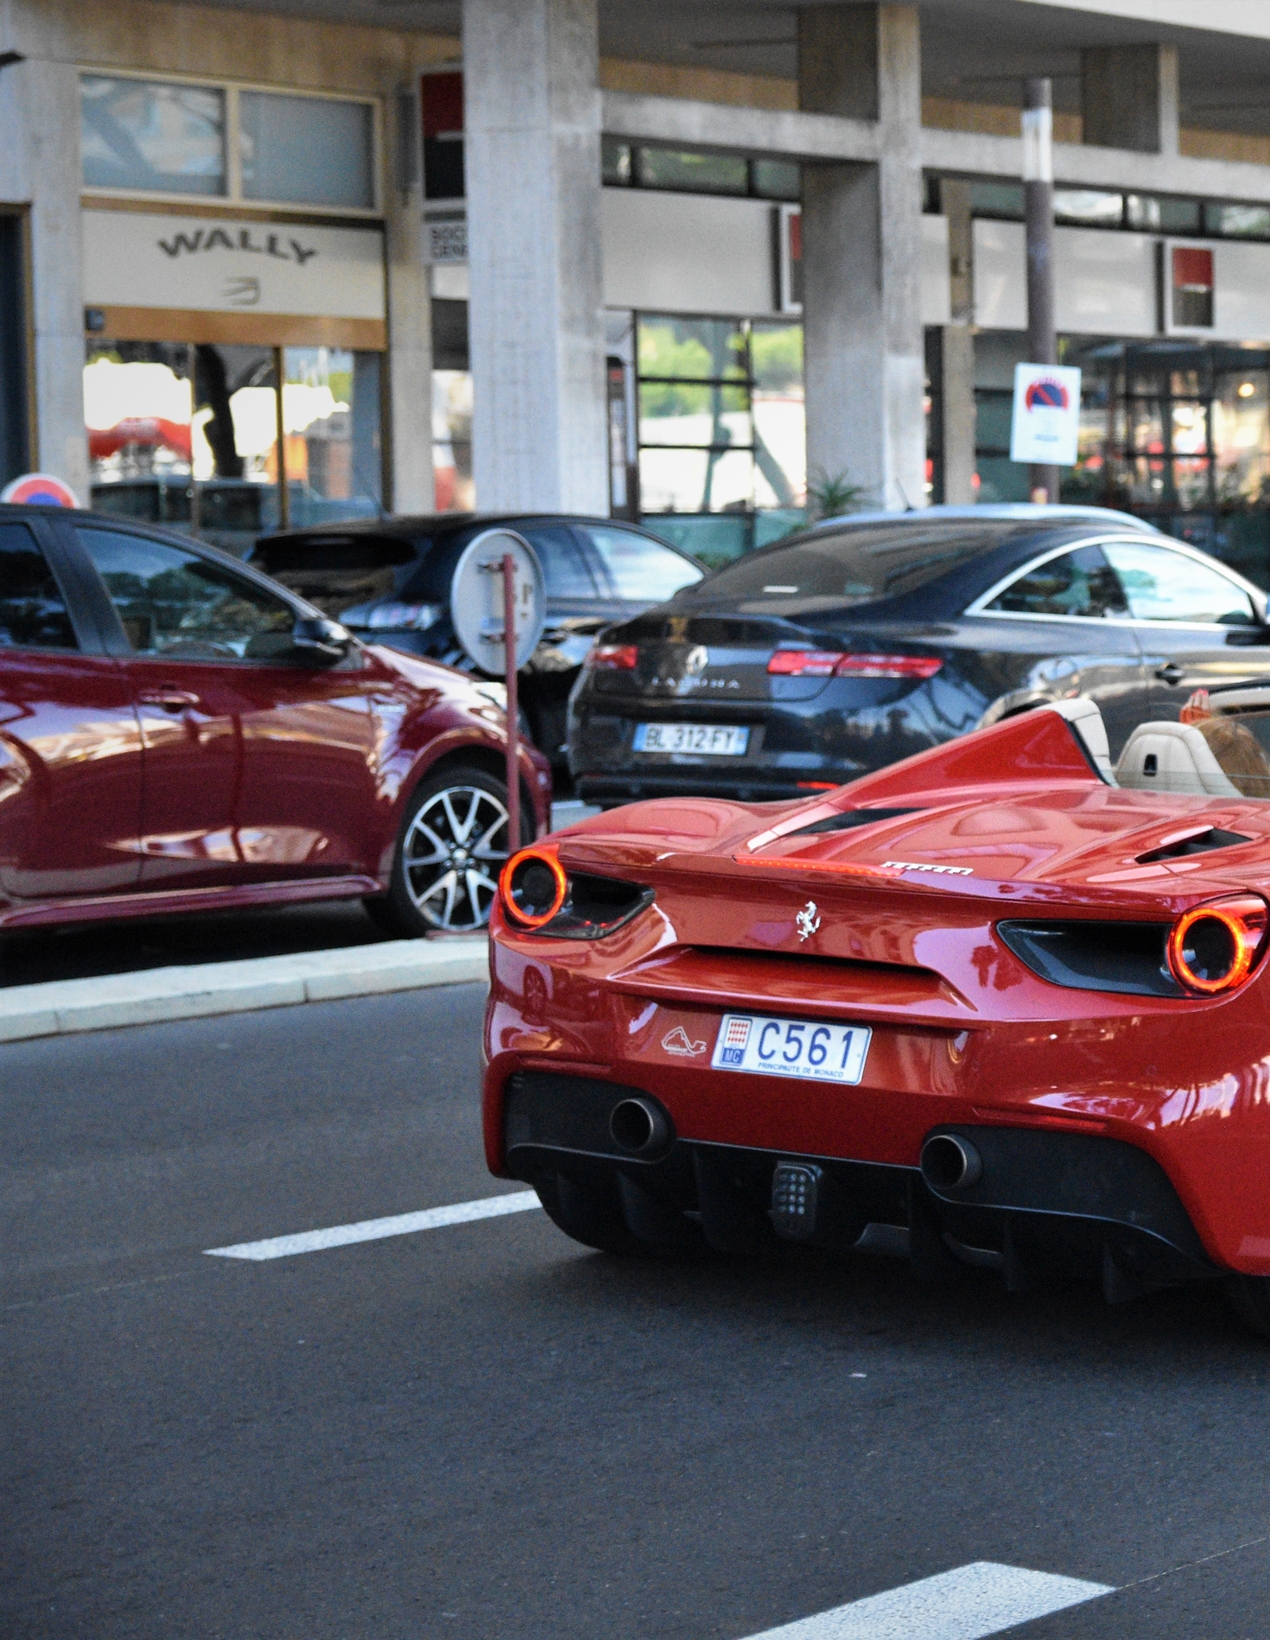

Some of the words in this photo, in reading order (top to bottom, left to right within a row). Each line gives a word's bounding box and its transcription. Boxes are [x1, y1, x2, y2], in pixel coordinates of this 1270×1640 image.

[158, 229, 316, 265] WALLY
[726, 1049, 741, 1063] MC
[757, 1021, 855, 1069] C561
[803, 1066, 811, 1075] DE
[814, 1067, 844, 1078] MONACO
